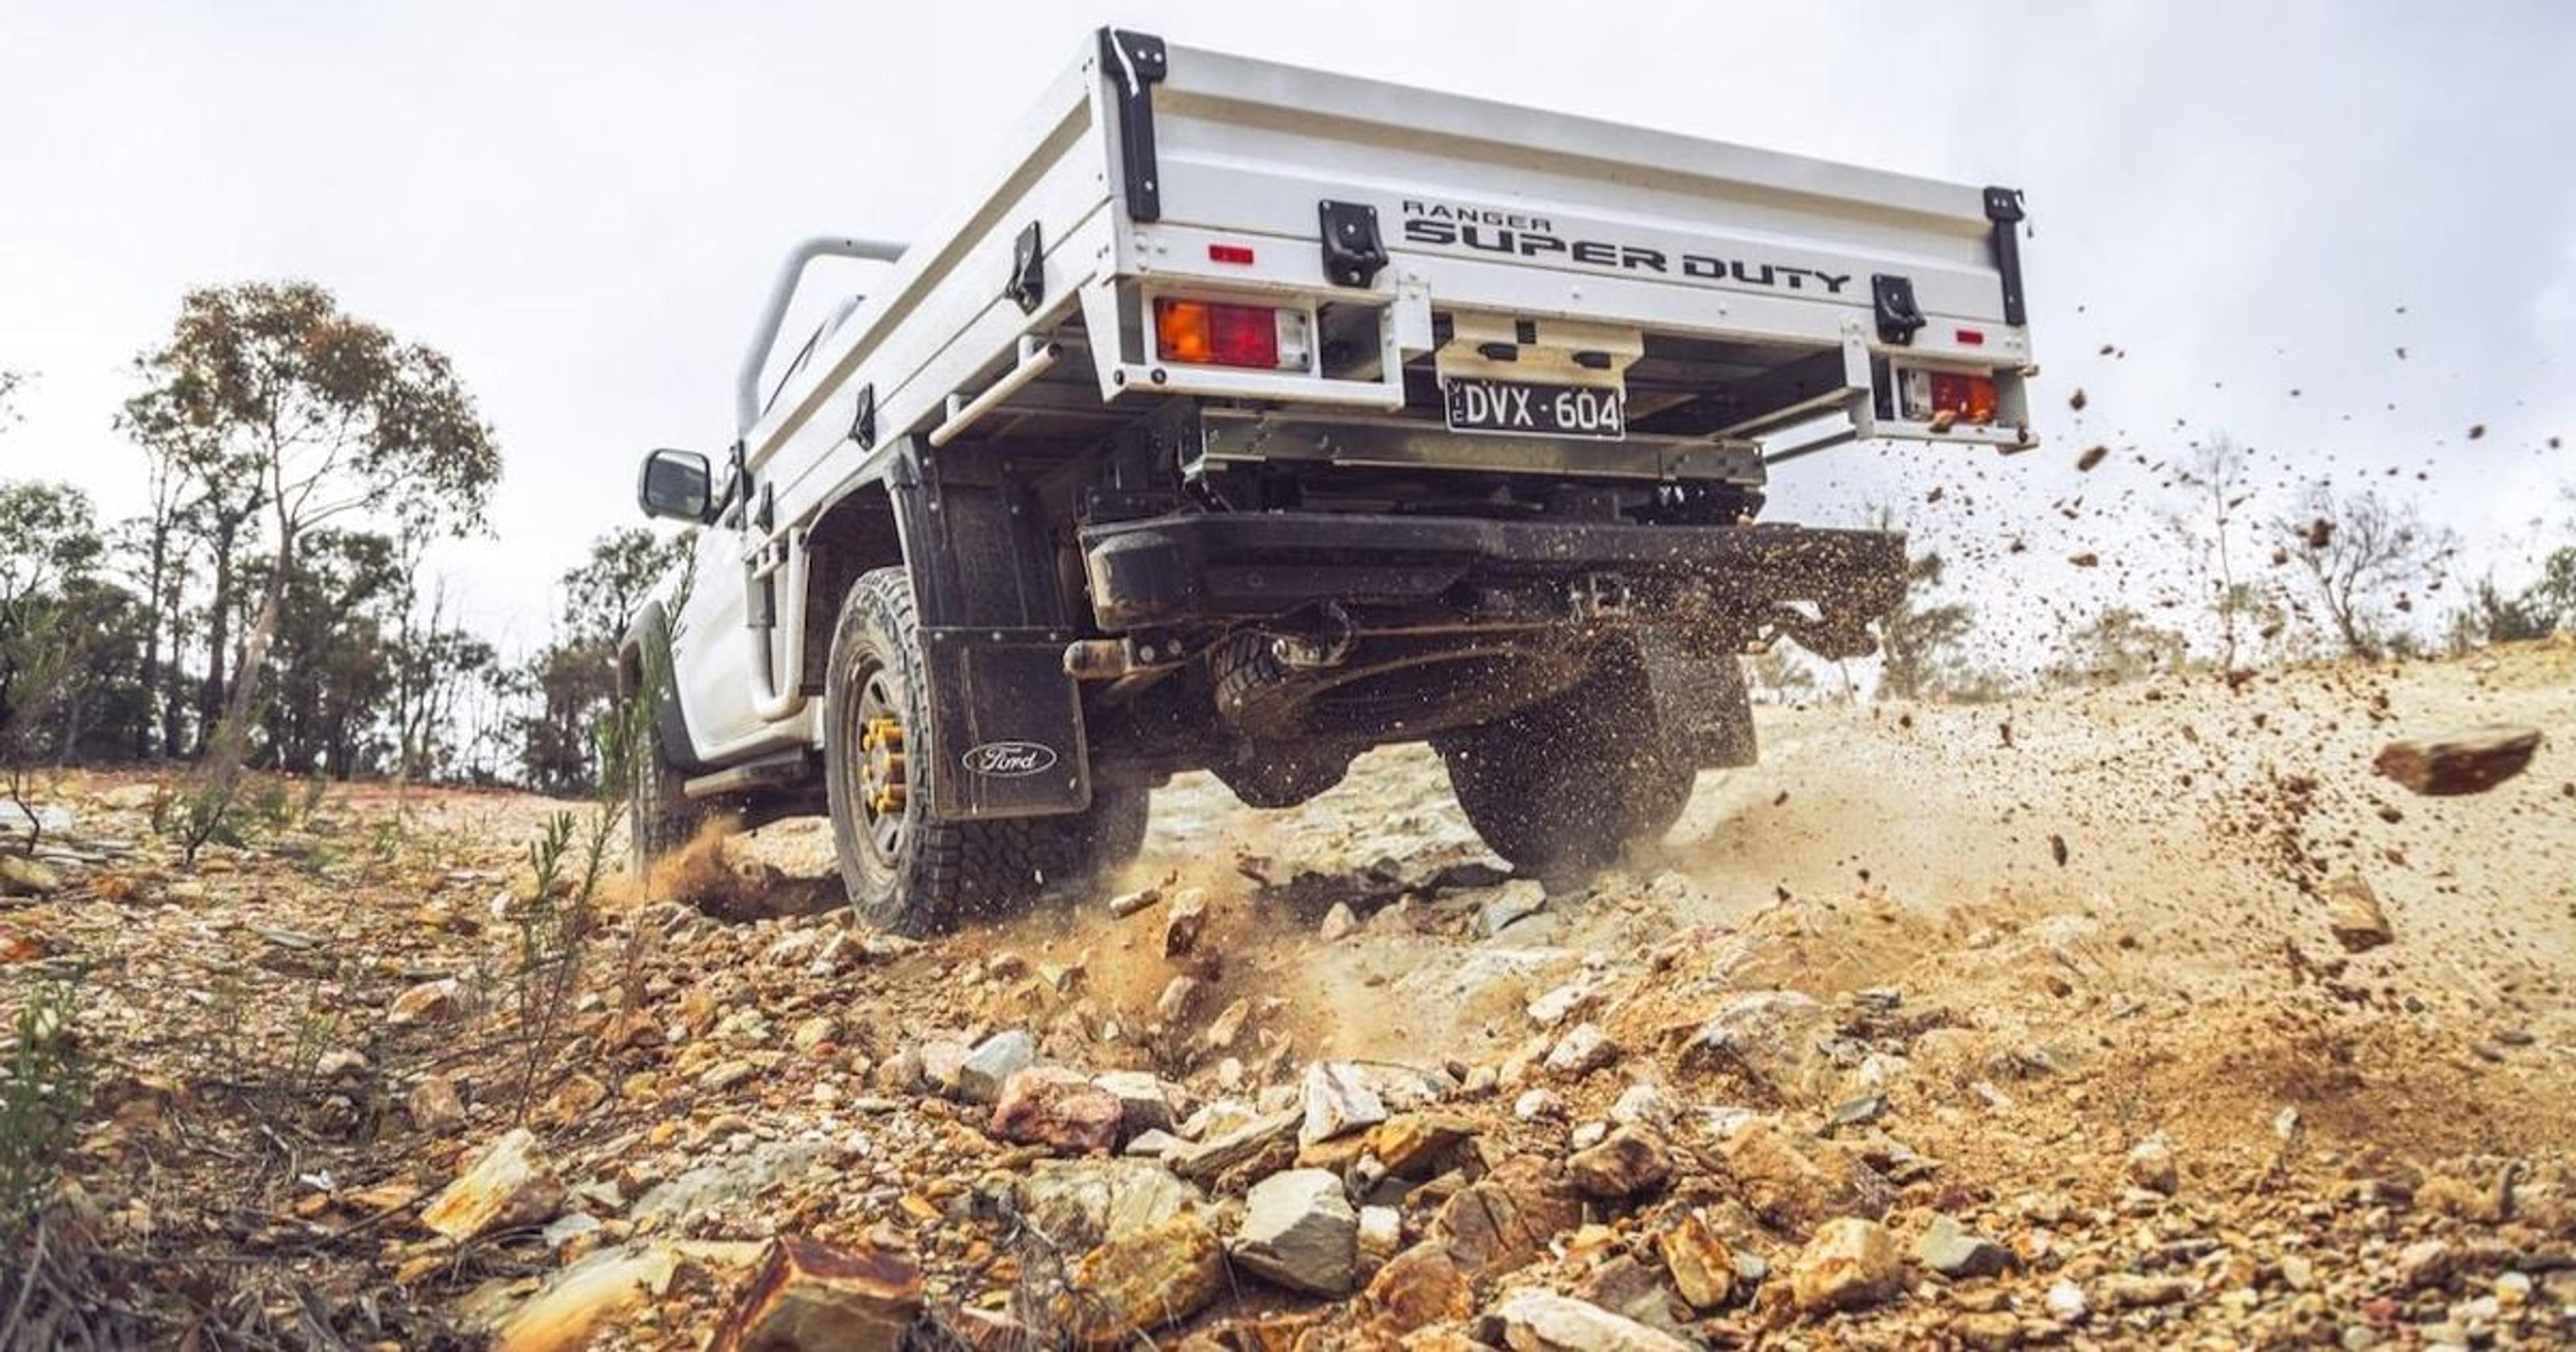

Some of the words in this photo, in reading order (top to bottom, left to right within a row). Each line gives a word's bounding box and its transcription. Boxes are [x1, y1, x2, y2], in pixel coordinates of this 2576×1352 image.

[1403, 200, 1551, 233] RANGER
[1405, 218, 1668, 272] SUPER
[1683, 254, 1851, 294] DUTY
[980, 746, 1038, 771] Ford
